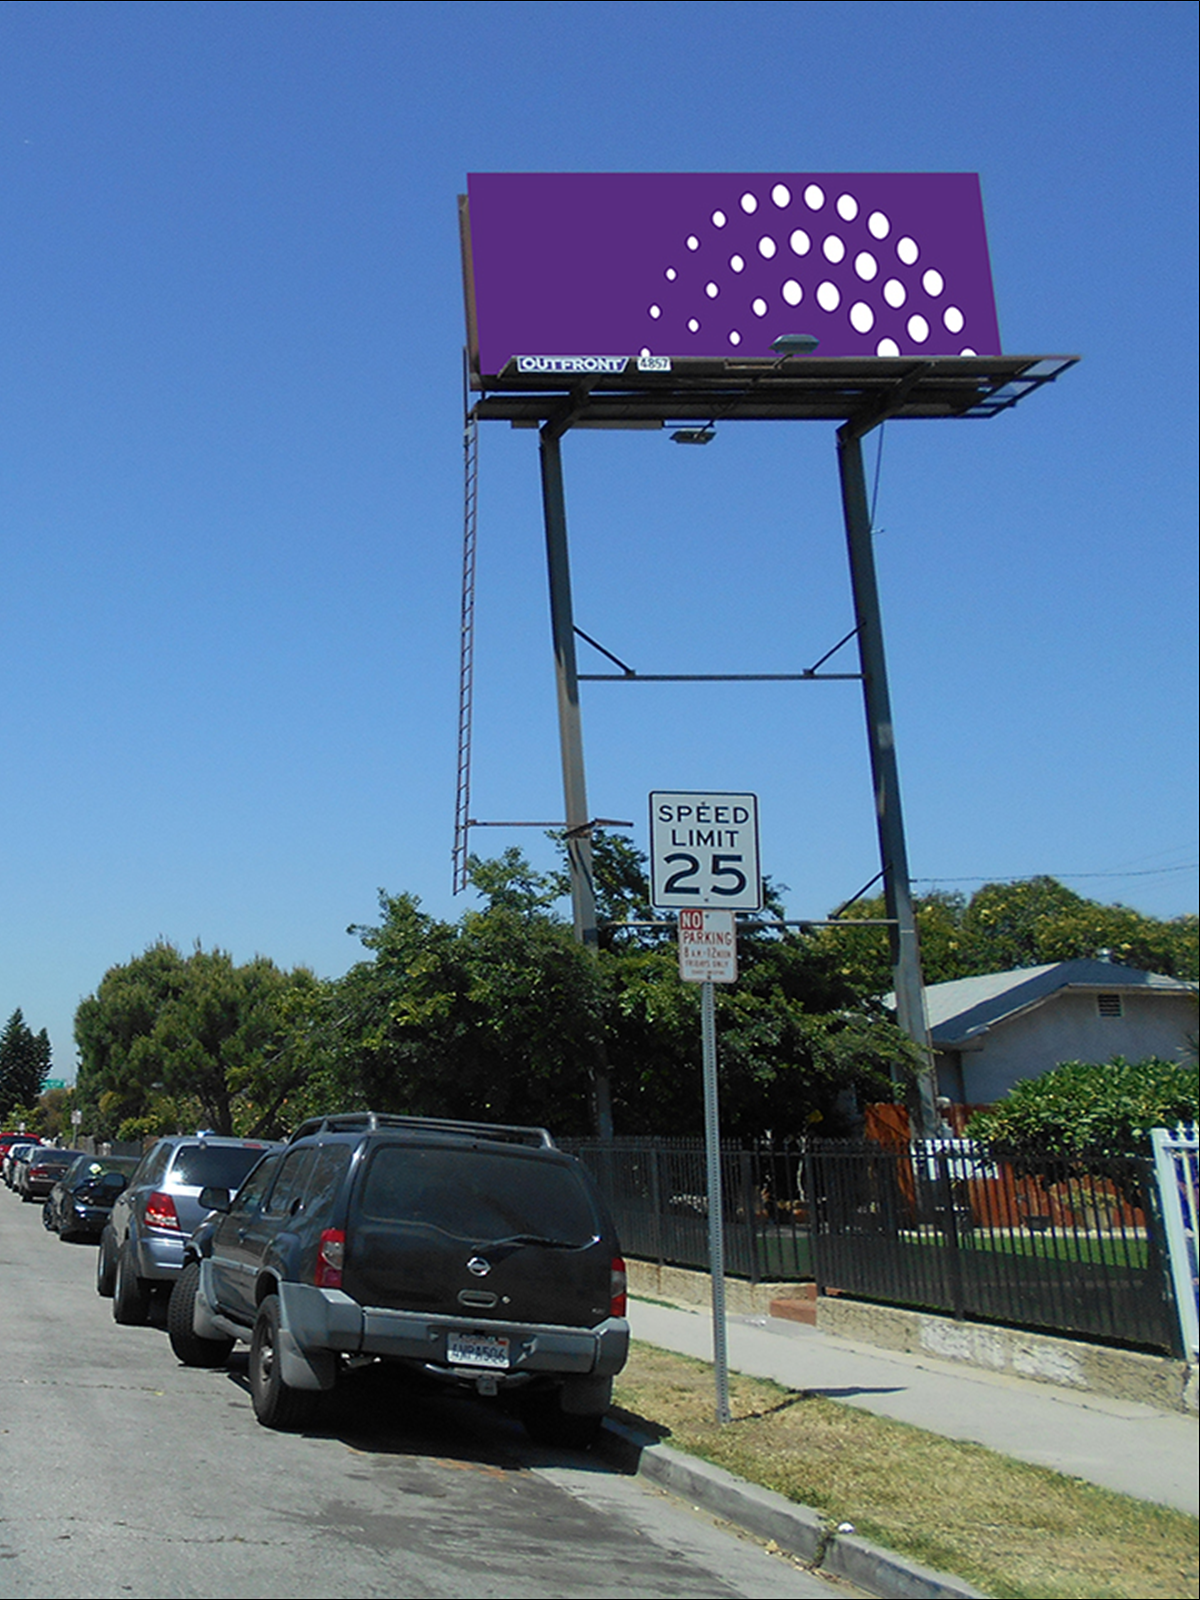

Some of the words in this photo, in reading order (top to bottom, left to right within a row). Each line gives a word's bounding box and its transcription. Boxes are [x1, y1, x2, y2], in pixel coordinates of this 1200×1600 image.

[521, 357, 620, 371] OUTFRONT
[640, 357, 668, 369] 4857
[658, 804, 749, 824] SPEED
[672, 829, 739, 847] LIMIT
[663, 853, 747, 895] 25
[681, 912, 702, 928] NO
[683, 931, 732, 946] PARKING
